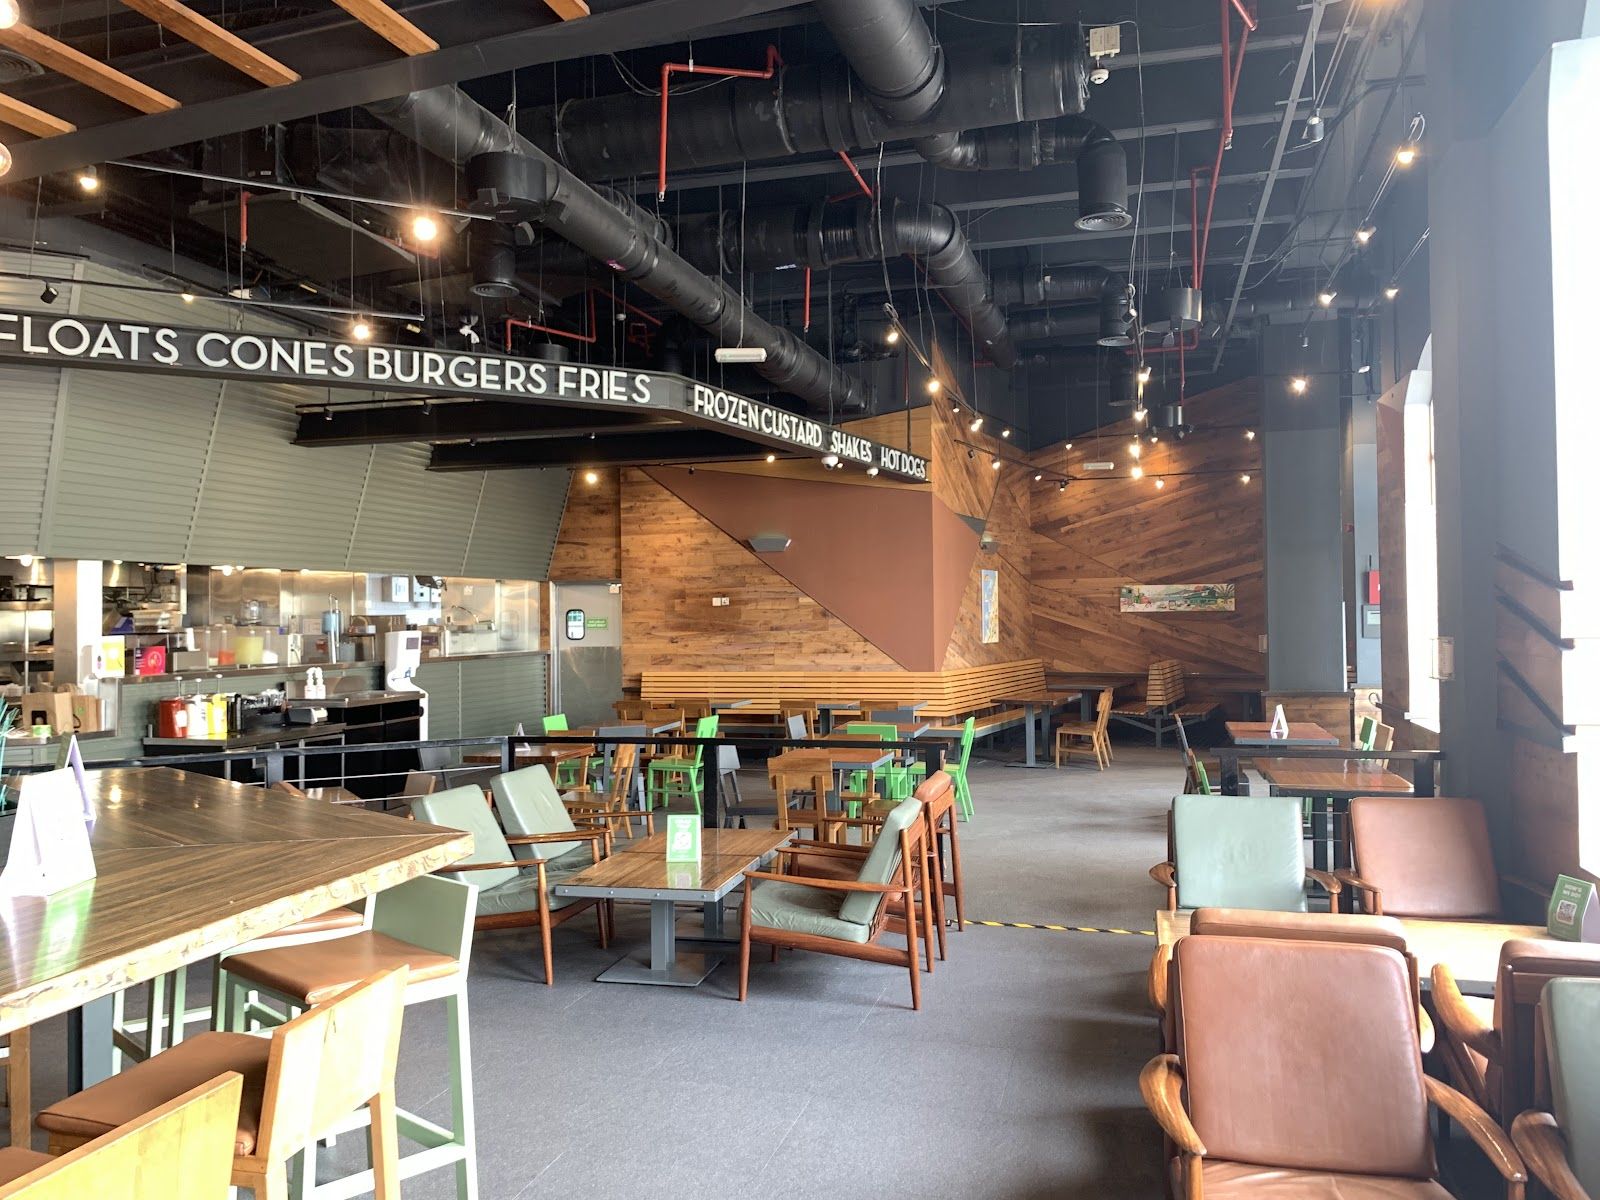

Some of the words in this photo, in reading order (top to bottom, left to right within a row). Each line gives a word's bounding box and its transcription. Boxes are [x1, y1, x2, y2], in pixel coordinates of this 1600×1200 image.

[196, 332, 355, 378] CONES
[368, 347, 547, 394] BURGERS
[559, 366, 651, 403] FRIES
[693, 384, 760, 430] FROZEN
[761, 408, 823, 447] CUSTARD
[830, 430, 872, 463] SHAKES
[880, 446, 901, 471] HOT
[901, 456, 926, 479] DOGS
